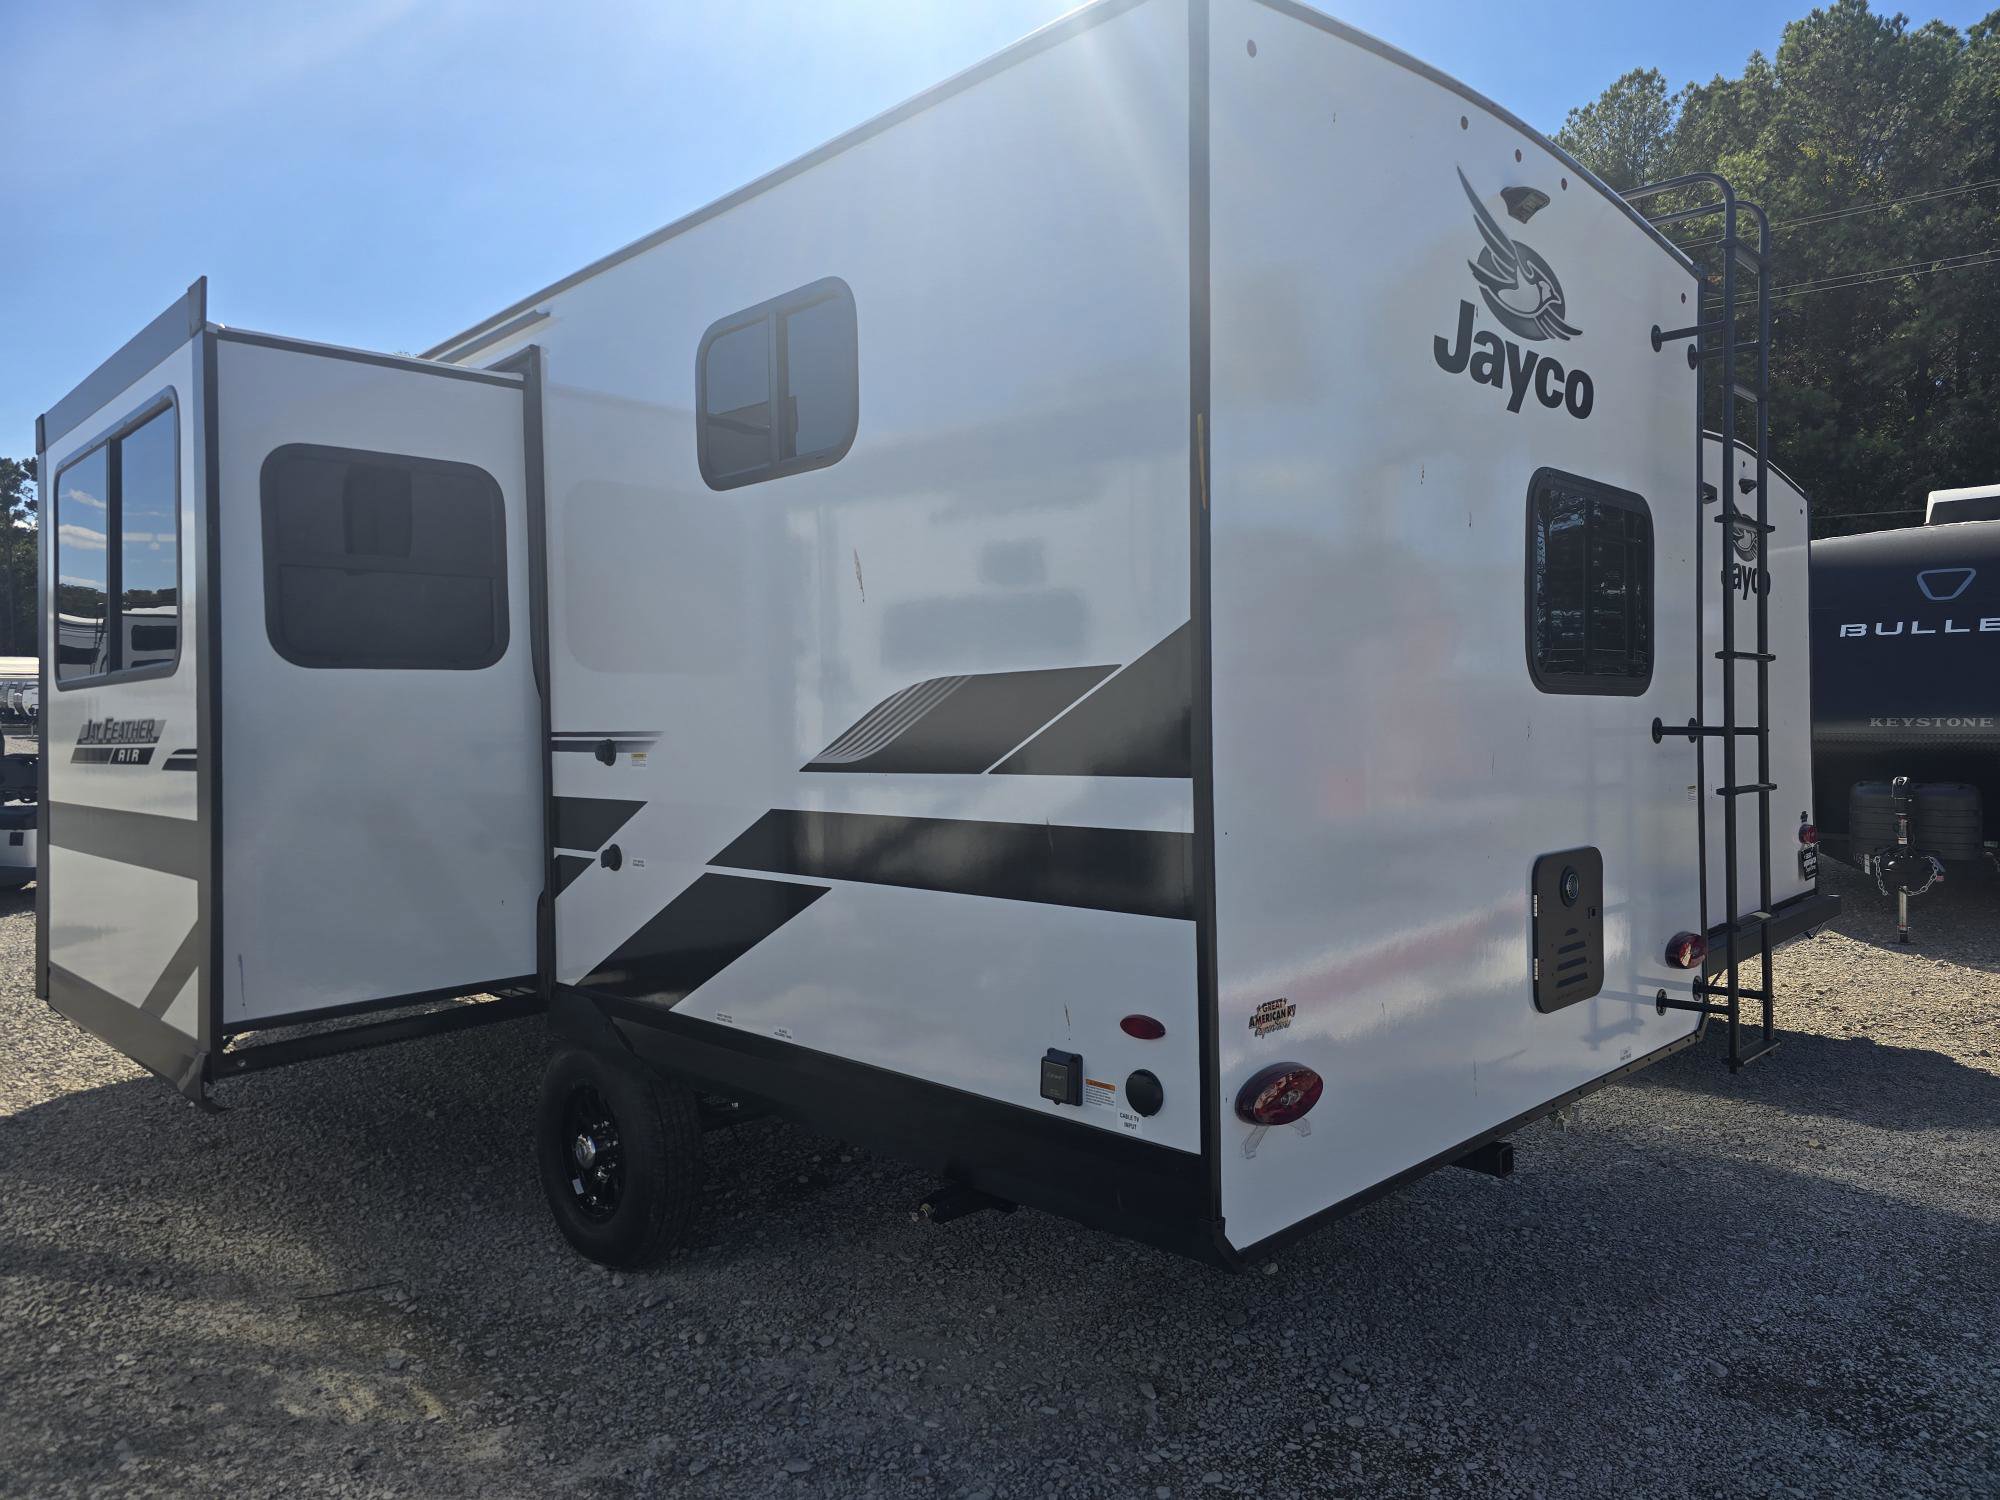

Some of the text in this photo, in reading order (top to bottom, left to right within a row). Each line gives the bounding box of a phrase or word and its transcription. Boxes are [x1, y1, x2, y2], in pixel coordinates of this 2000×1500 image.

[1433, 299, 1594, 420] Jayco
[1839, 617, 2000, 638] BULLE
[84, 717, 155, 740] JAY FEATHER
[1869, 716, 1994, 728] KEYSTONE
[117, 748, 140, 762] AIR
[1249, 1009, 1286, 1029] AMERICAN
[1287, 1004, 1297, 1018] RV
[1123, 1121, 1137, 1131] INPUT
